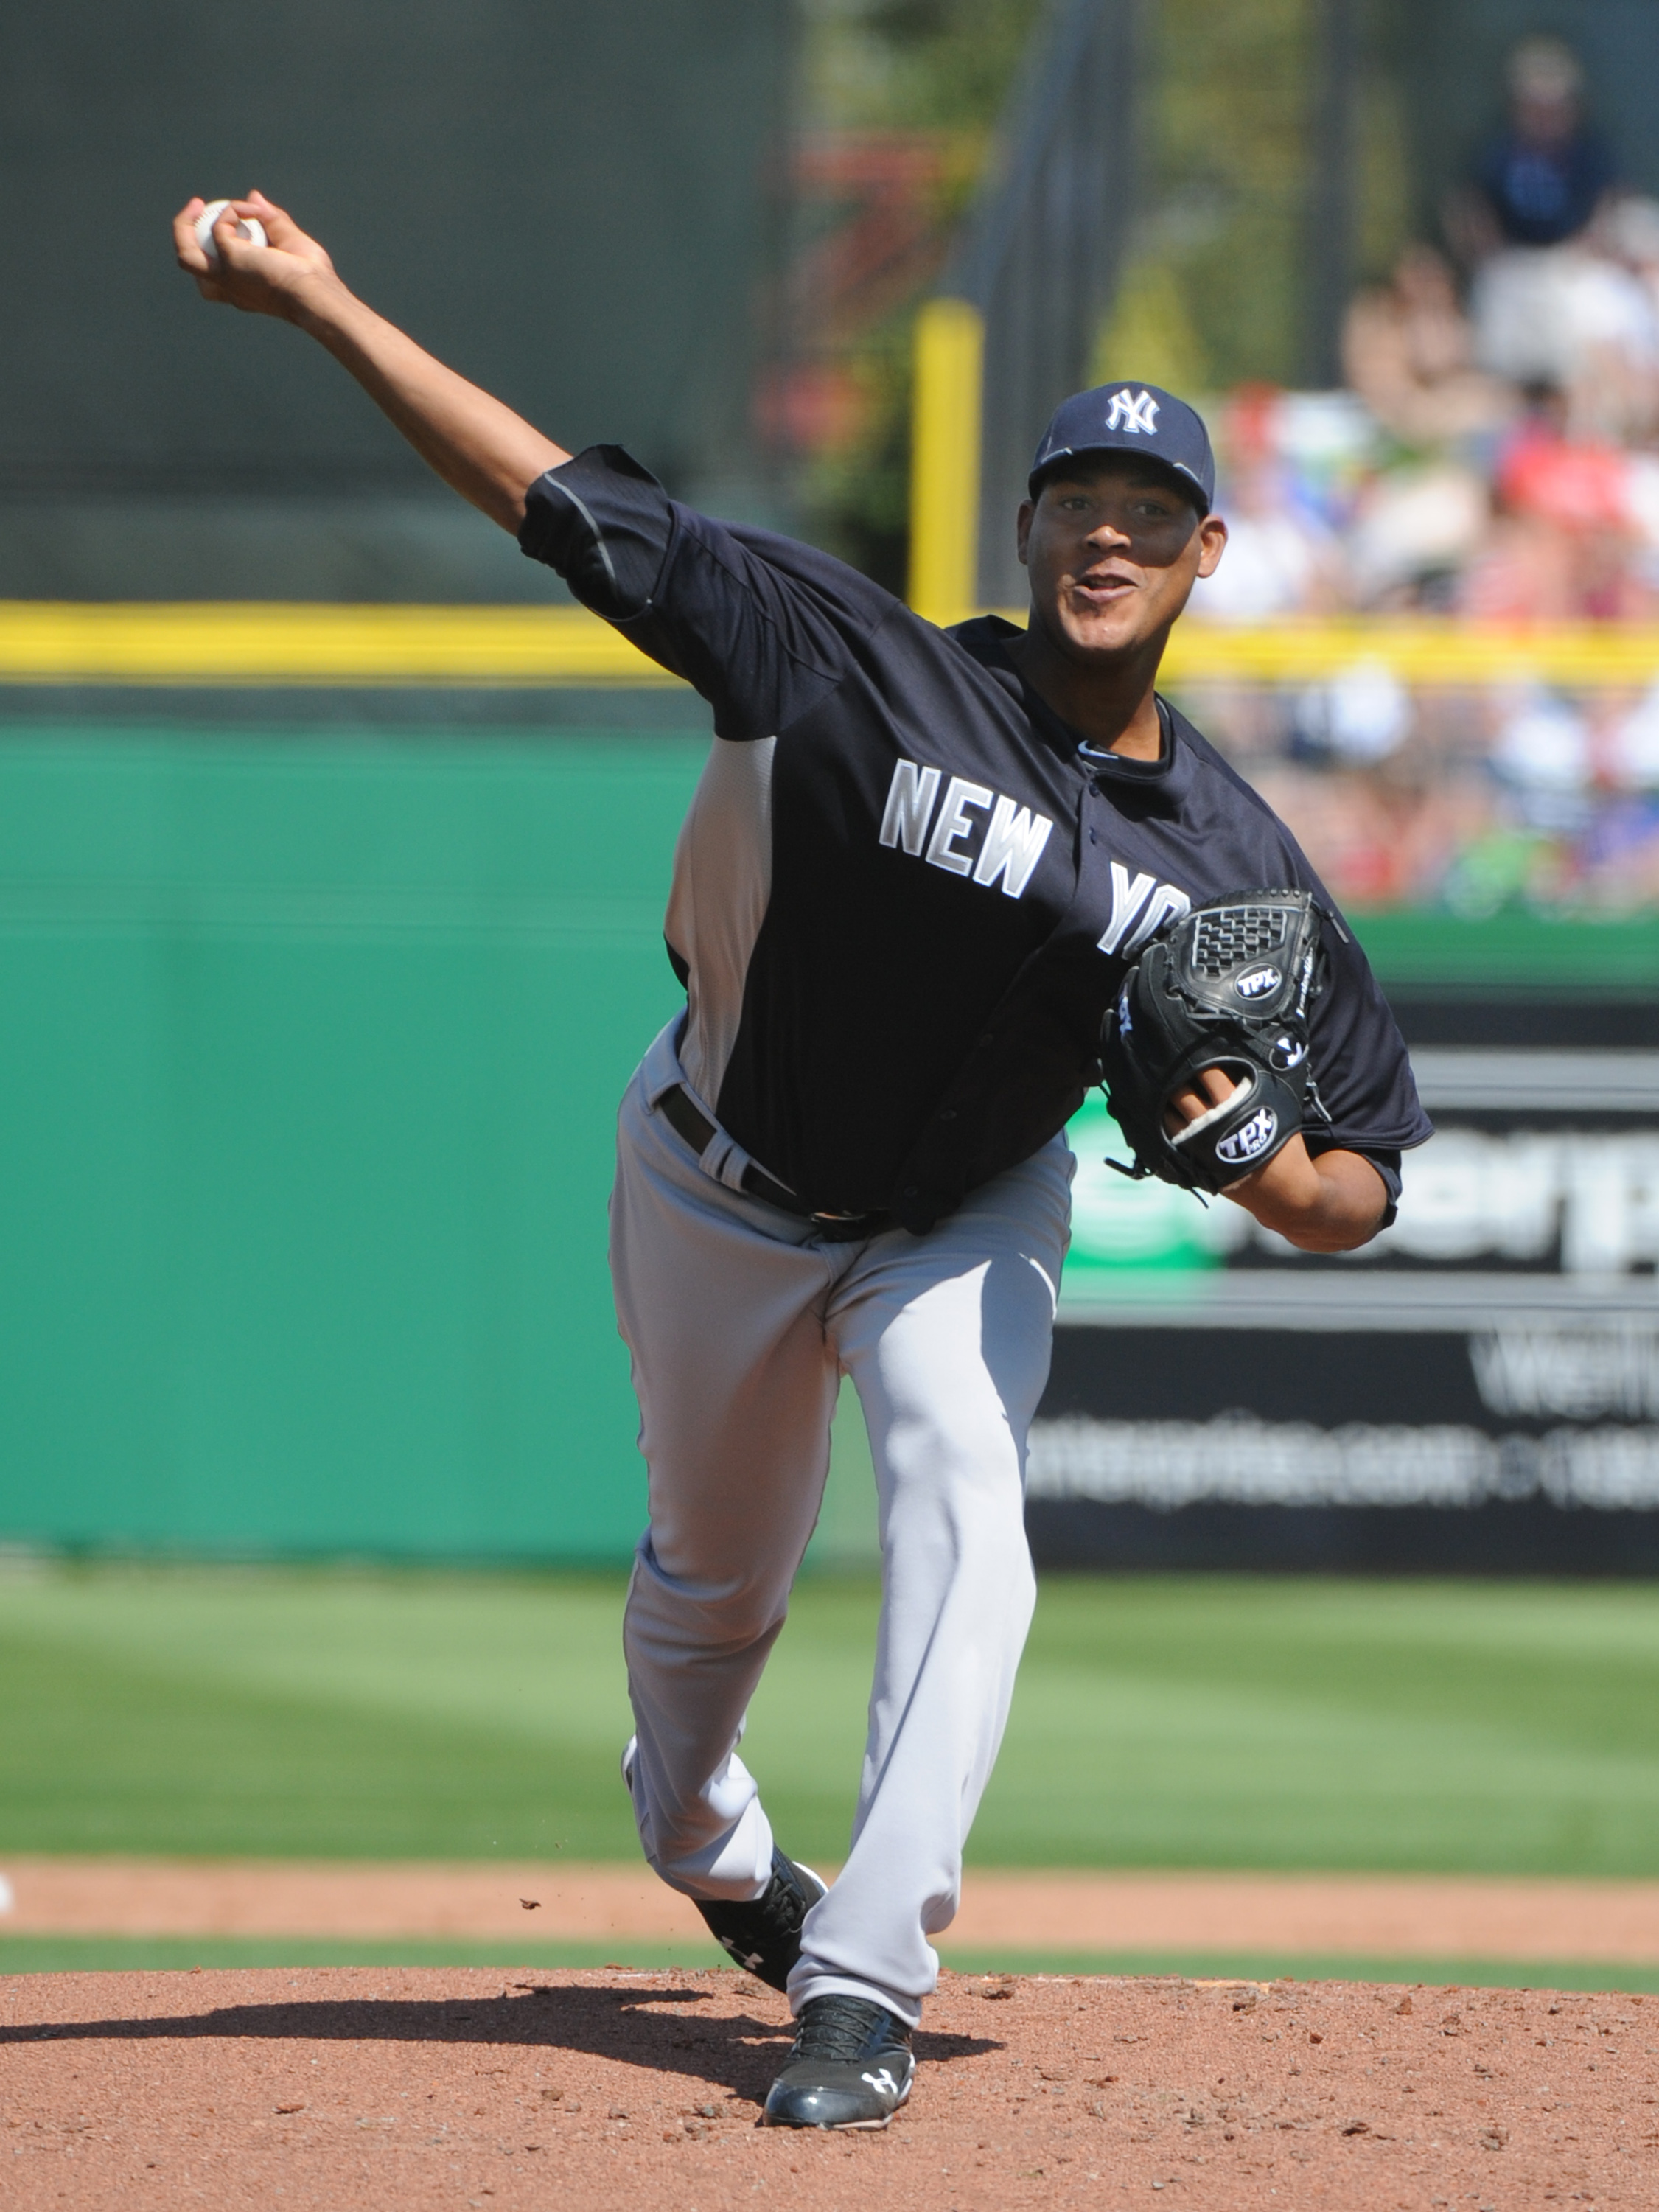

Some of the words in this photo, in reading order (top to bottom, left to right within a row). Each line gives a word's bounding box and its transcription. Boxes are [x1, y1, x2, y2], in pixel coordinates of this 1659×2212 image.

[1106, 388, 1160, 436] NY
[879, 758, 1053, 899] NEW
[1237, 968, 1276, 996] TPX
[1220, 1108, 1272, 1157] TPX
